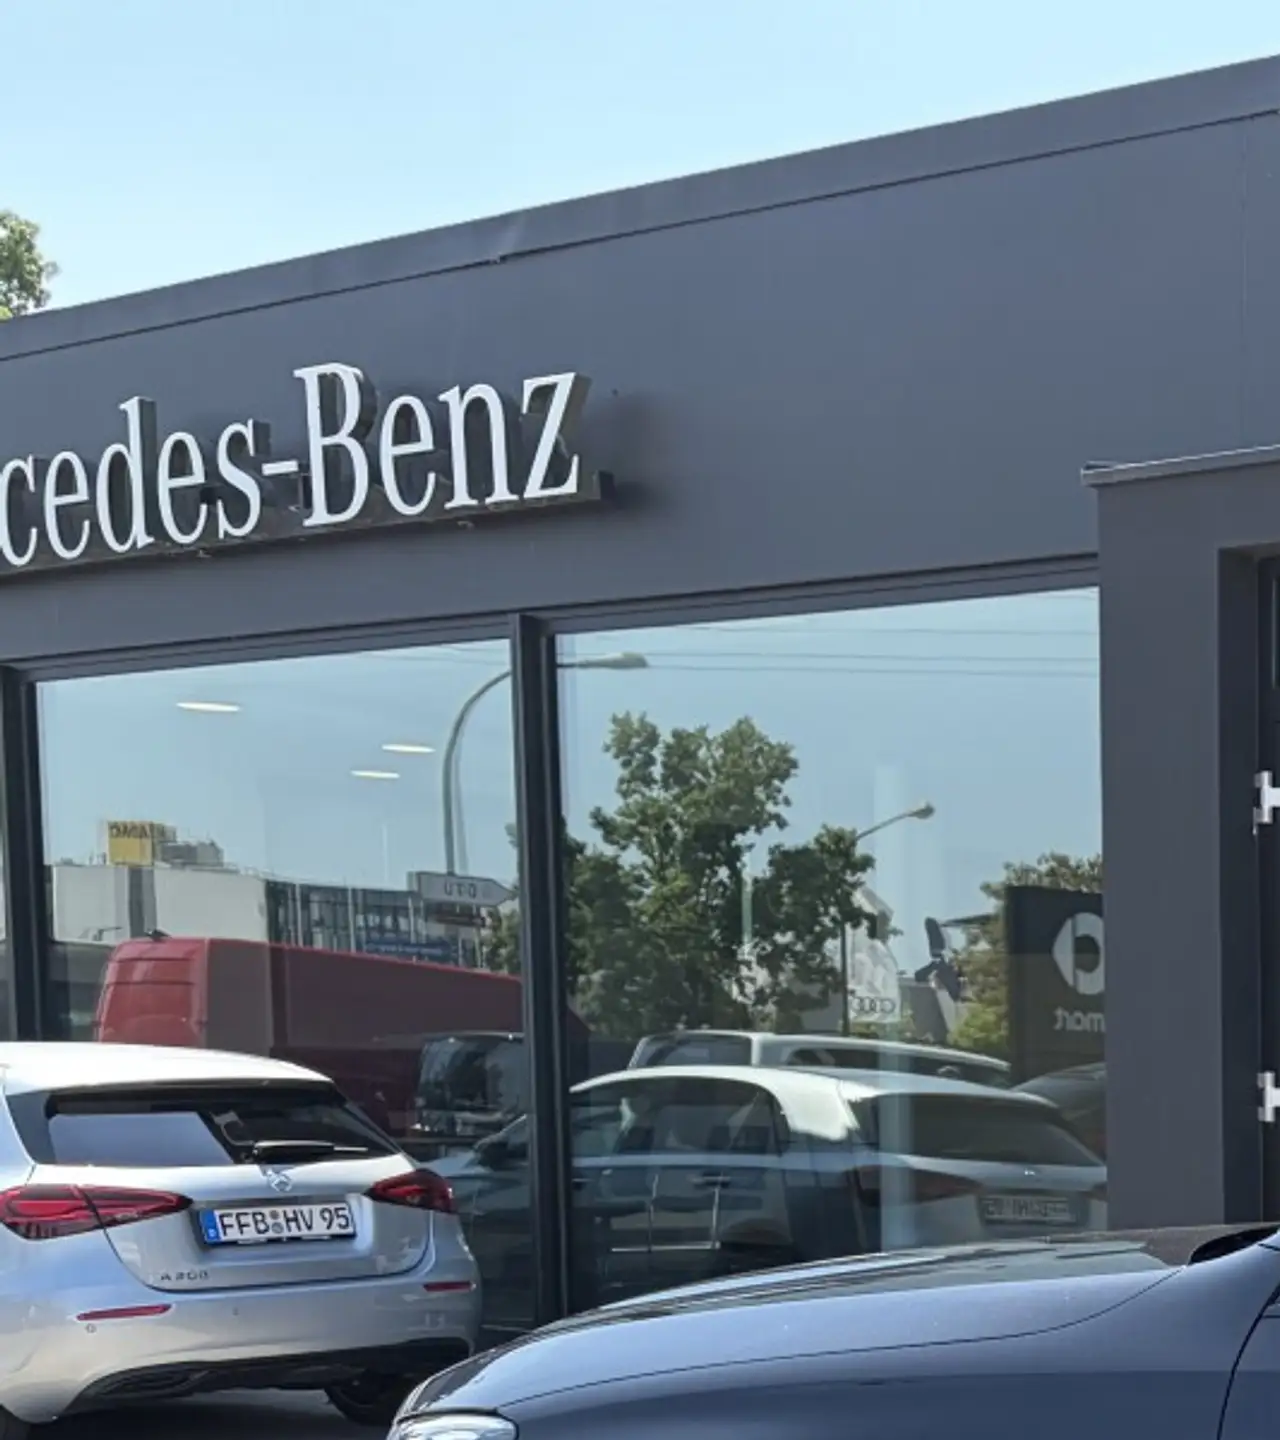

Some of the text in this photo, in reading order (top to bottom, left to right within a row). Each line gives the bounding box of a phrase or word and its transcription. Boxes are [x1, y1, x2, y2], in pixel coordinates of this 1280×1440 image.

[219, 1207, 351, 1237] FFB HV 95
